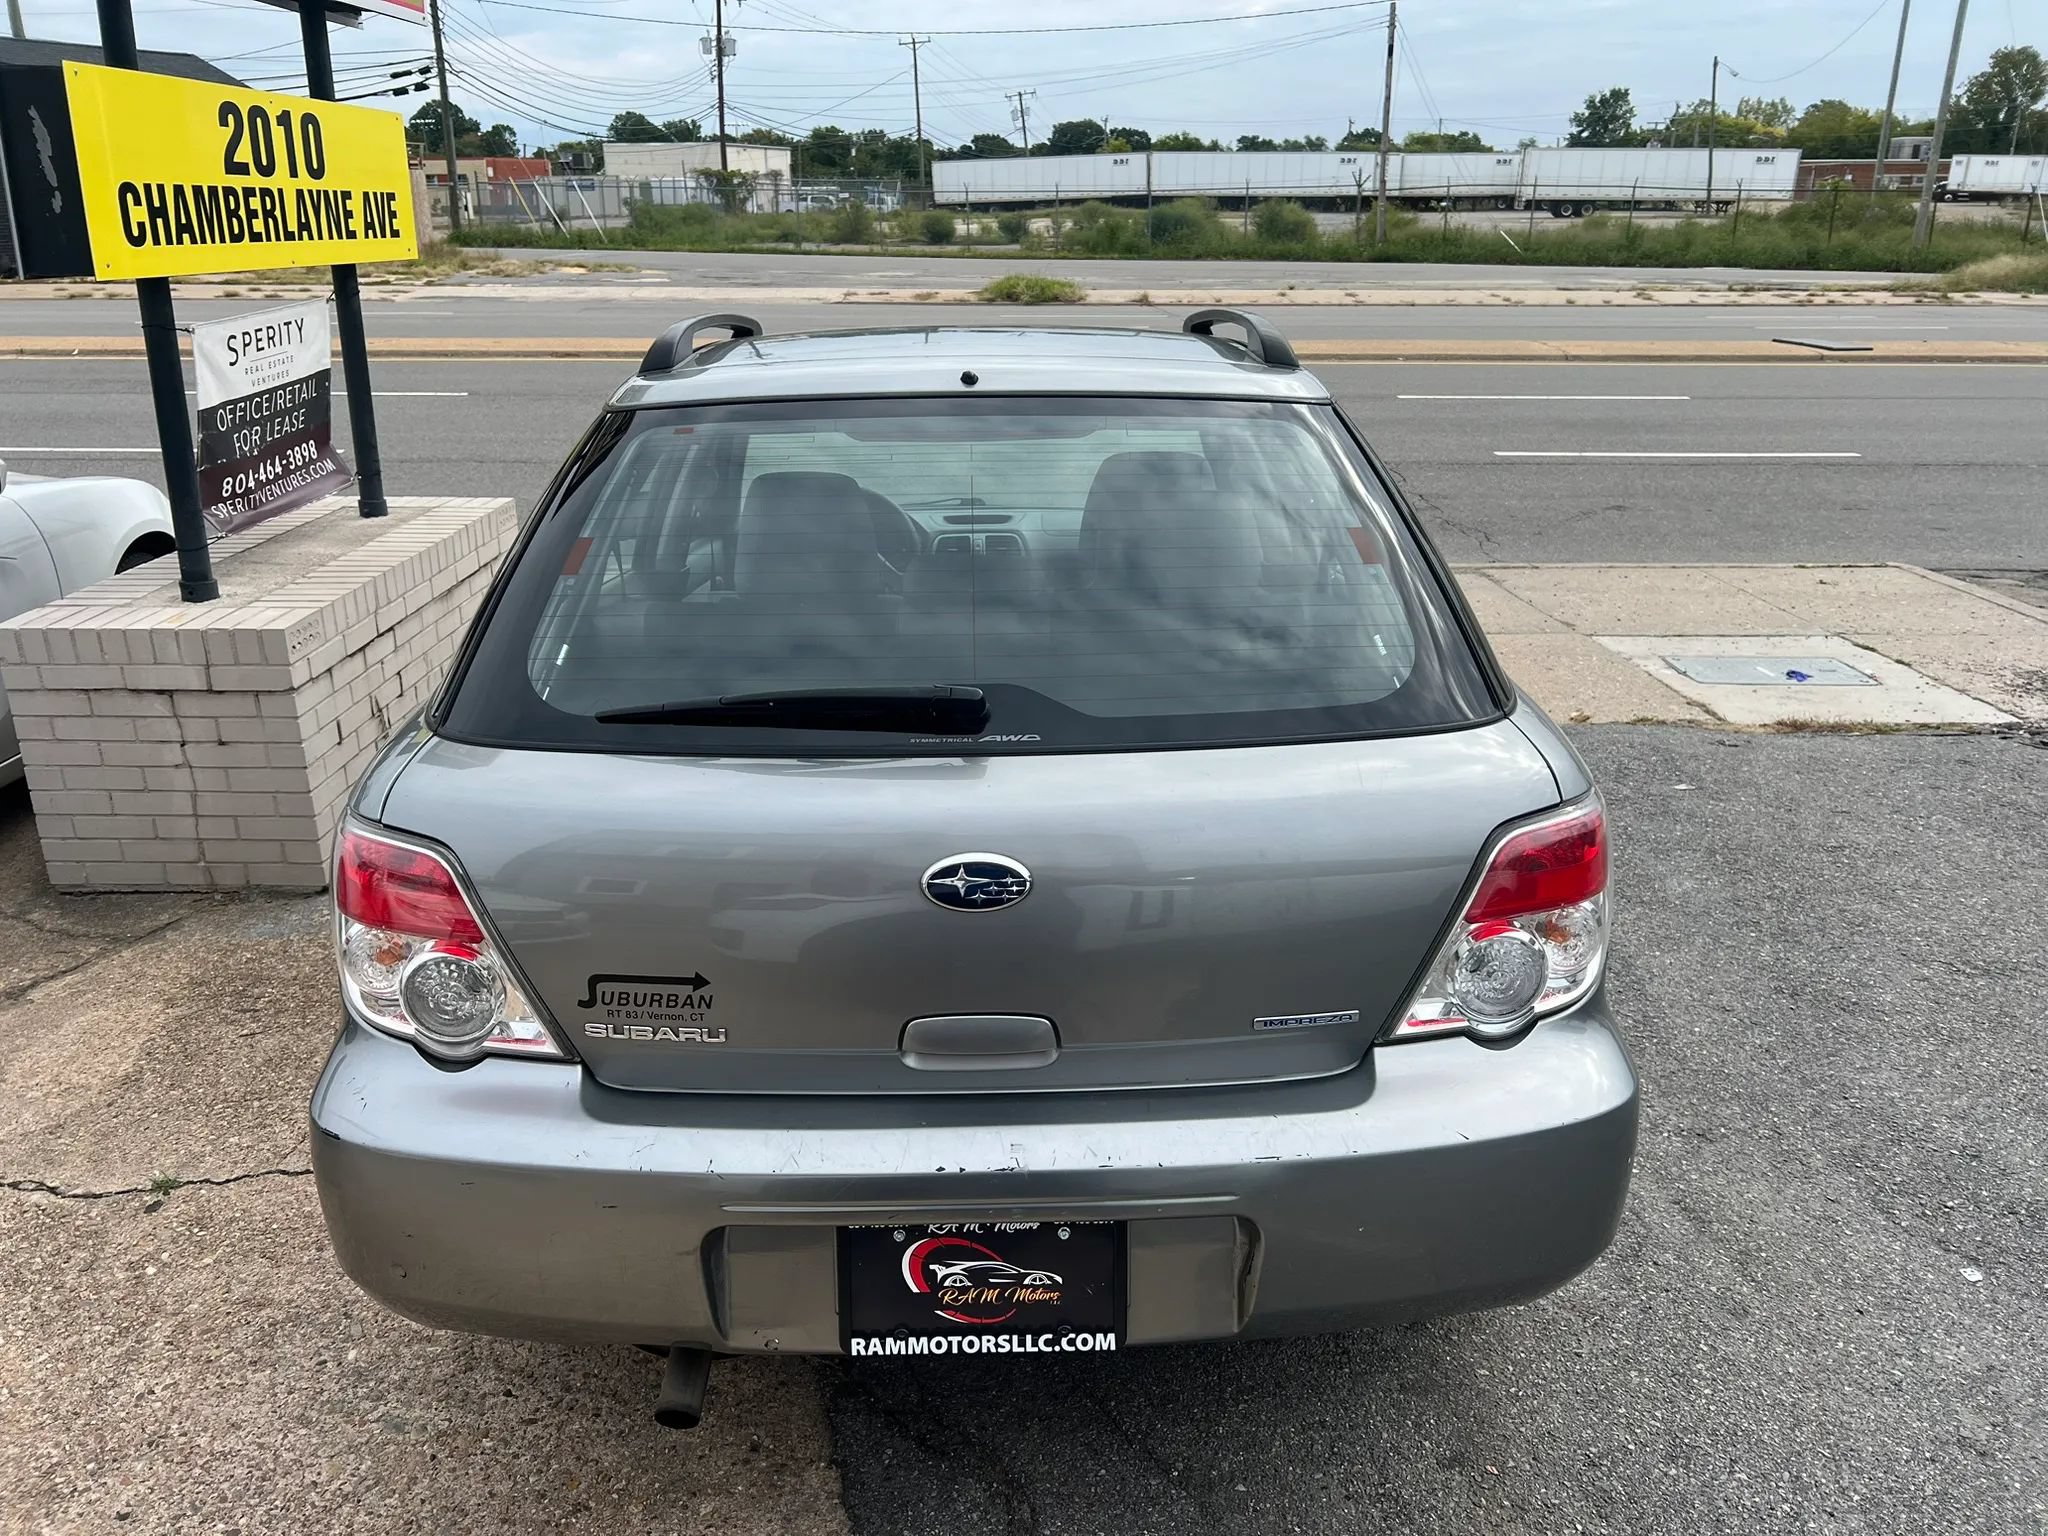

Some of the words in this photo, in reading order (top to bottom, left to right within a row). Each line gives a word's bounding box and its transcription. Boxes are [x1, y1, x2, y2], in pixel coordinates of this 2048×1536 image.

[218, 101, 327, 181] 2010
[118, 181, 357, 248] CHAMBERLAYNE
[362, 191, 401, 240] AVE
[226, 317, 305, 367] SPERITY
[244, 365, 264, 376] REAL
[268, 355, 294, 370] ESTATE
[251, 370, 290, 387] VENTURES
[216, 378, 318, 432] OFFICE/RETAIL
[233, 427, 261, 455] FOR
[266, 409, 306, 442] LEASE
[222, 439, 318, 498] 804-464-3898
[211, 458, 336, 519] SPERITYVENTURES.COM
[978, 734, 1041, 742] AWD
[577, 971, 713, 1009] SUBURBAN
[607, 1009, 622, 1018] RT
[625, 1010, 638, 1019] 83
[646, 1011, 687, 1022] Vernon,
[690, 1012, 705, 1021] CT
[1263, 1014, 1353, 1028] IMPREZA
[584, 1022, 728, 1043] SUBARU
[938, 1287, 1003, 1306] RAM
[1005, 1286, 1061, 1304] Motors
[850, 1333, 1117, 1356] RAMMOTORSLLC.COM
